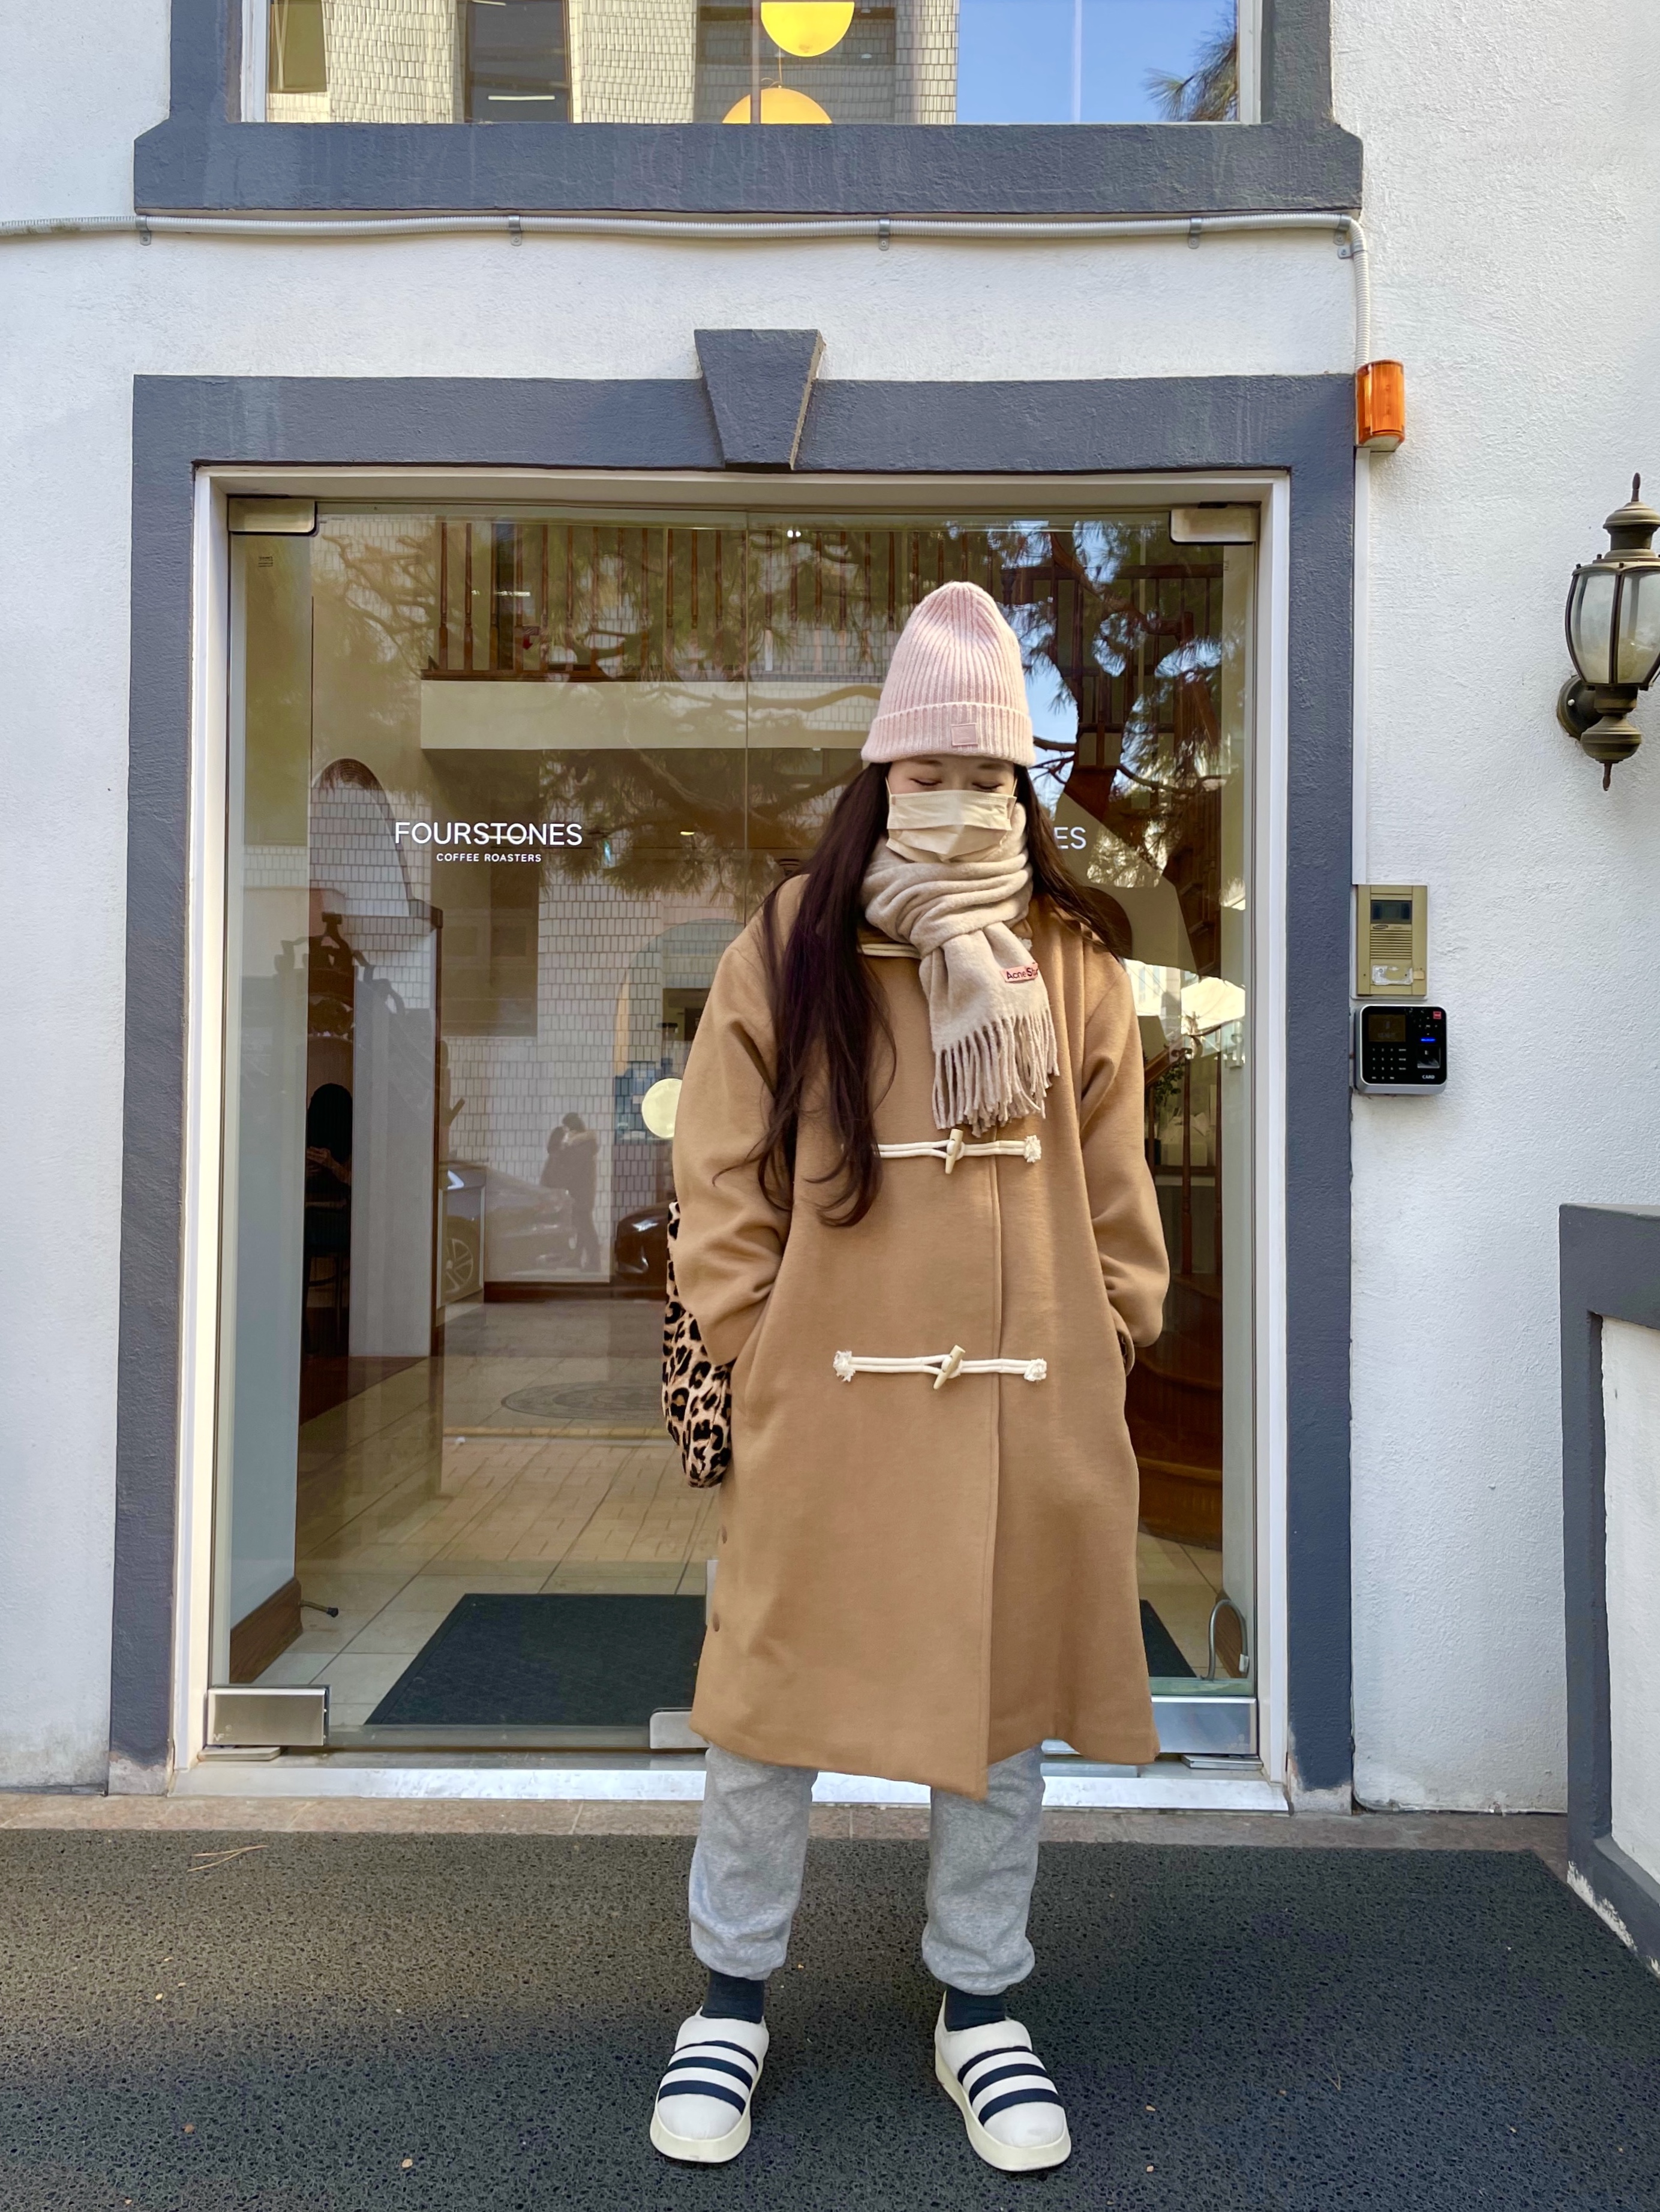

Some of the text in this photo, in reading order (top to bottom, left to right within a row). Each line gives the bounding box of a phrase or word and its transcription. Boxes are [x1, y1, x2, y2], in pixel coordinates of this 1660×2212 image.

[395, 821, 583, 846] FOURSTONES
[436, 853, 541, 863] COFFEE ROASTERS
[1006, 971, 1026, 980] Acne
